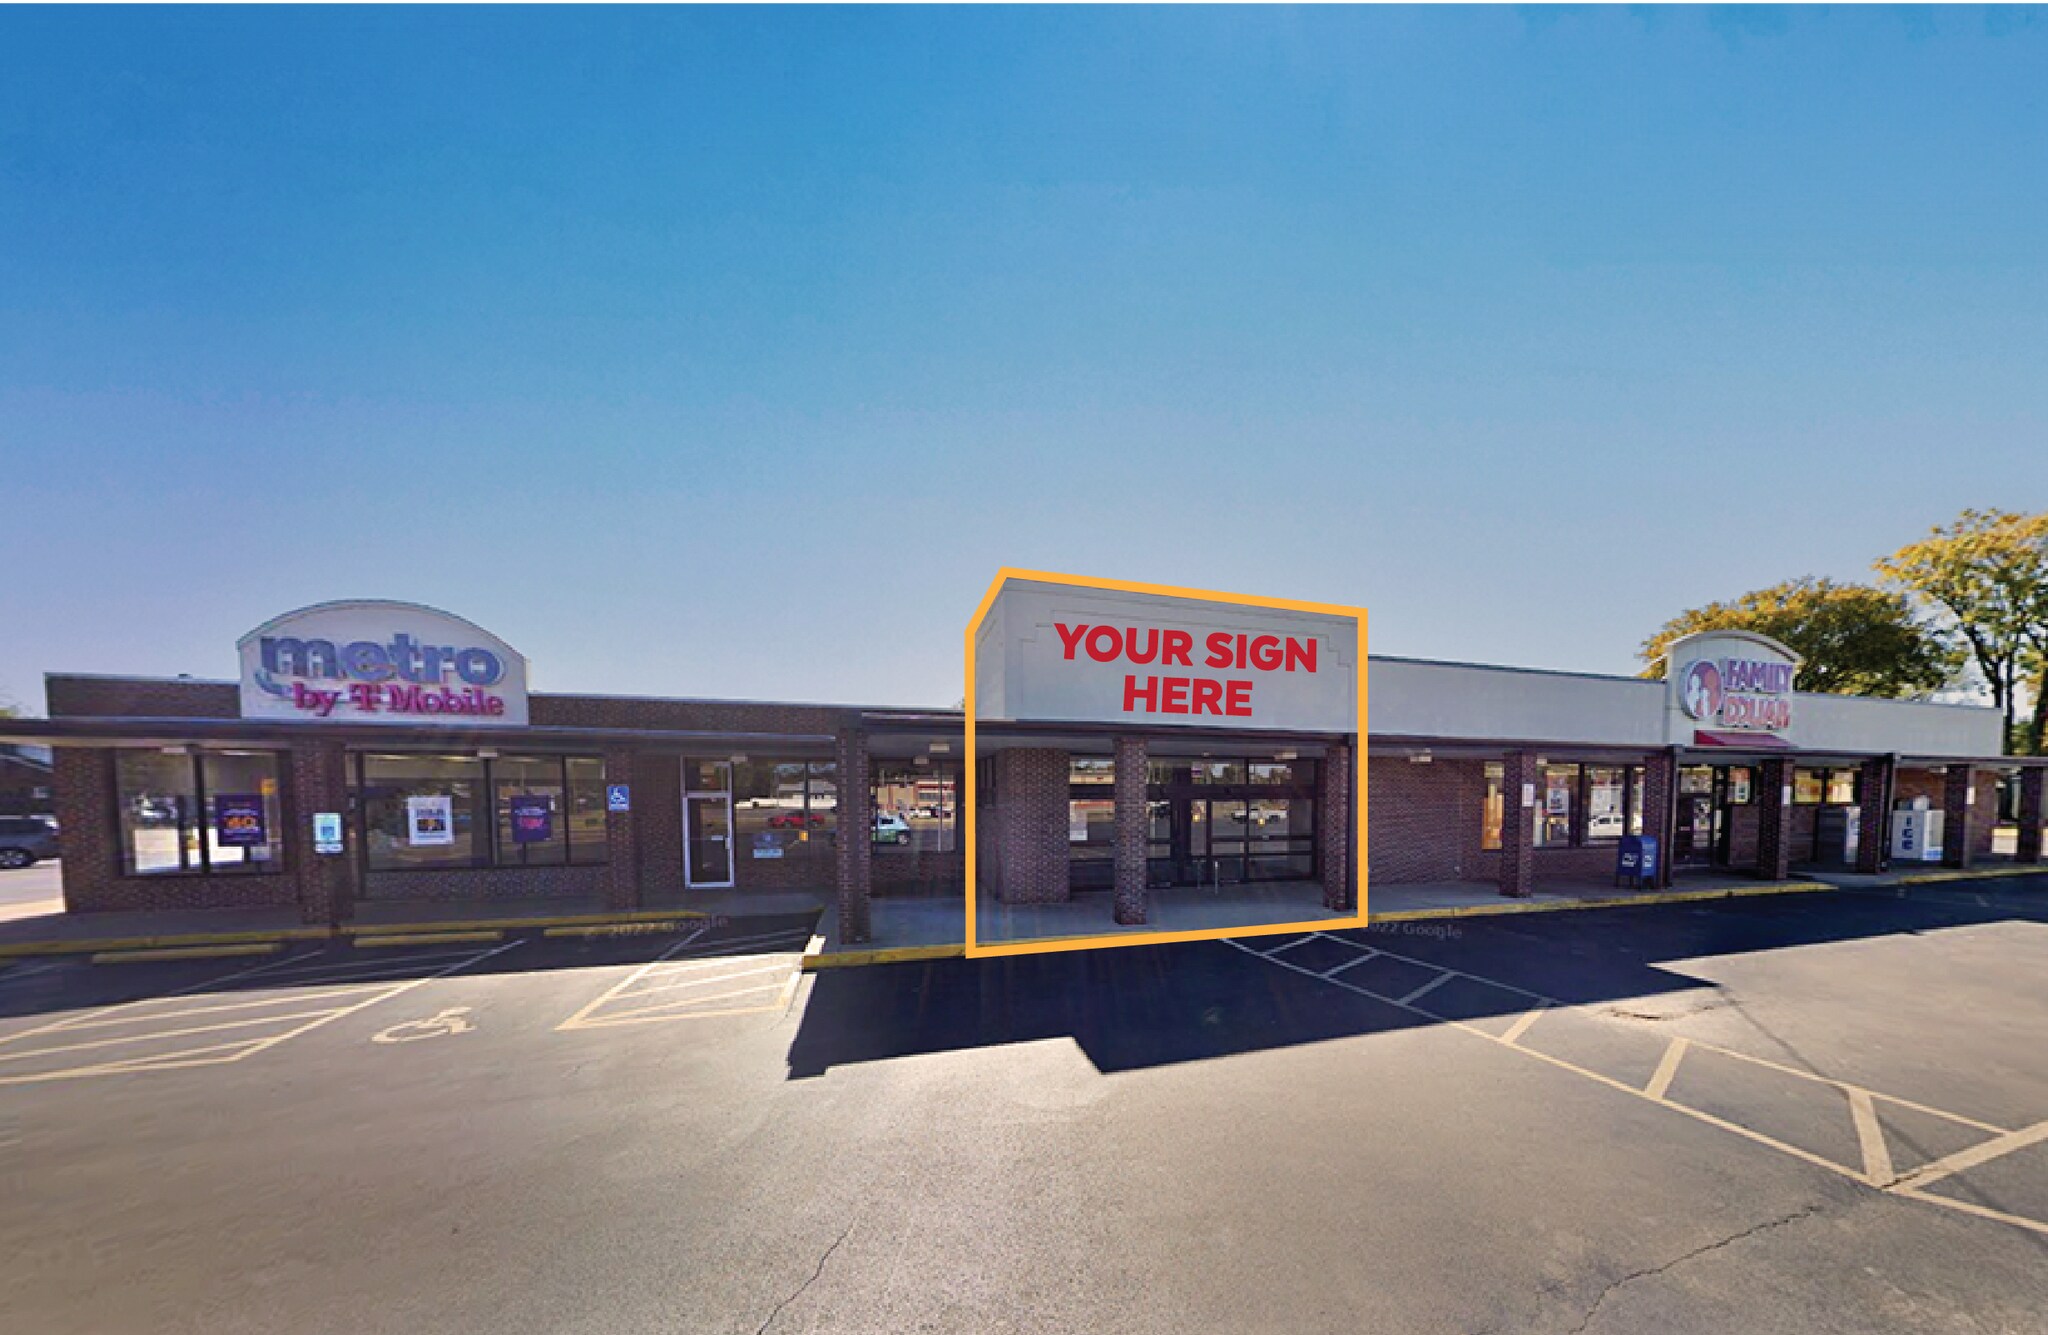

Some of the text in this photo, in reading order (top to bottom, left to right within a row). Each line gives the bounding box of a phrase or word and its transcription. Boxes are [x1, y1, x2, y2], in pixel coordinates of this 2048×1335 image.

[260, 633, 500, 685] metro
[293, 682, 341, 717] by
[1901, 816, 1914, 850] ICE
